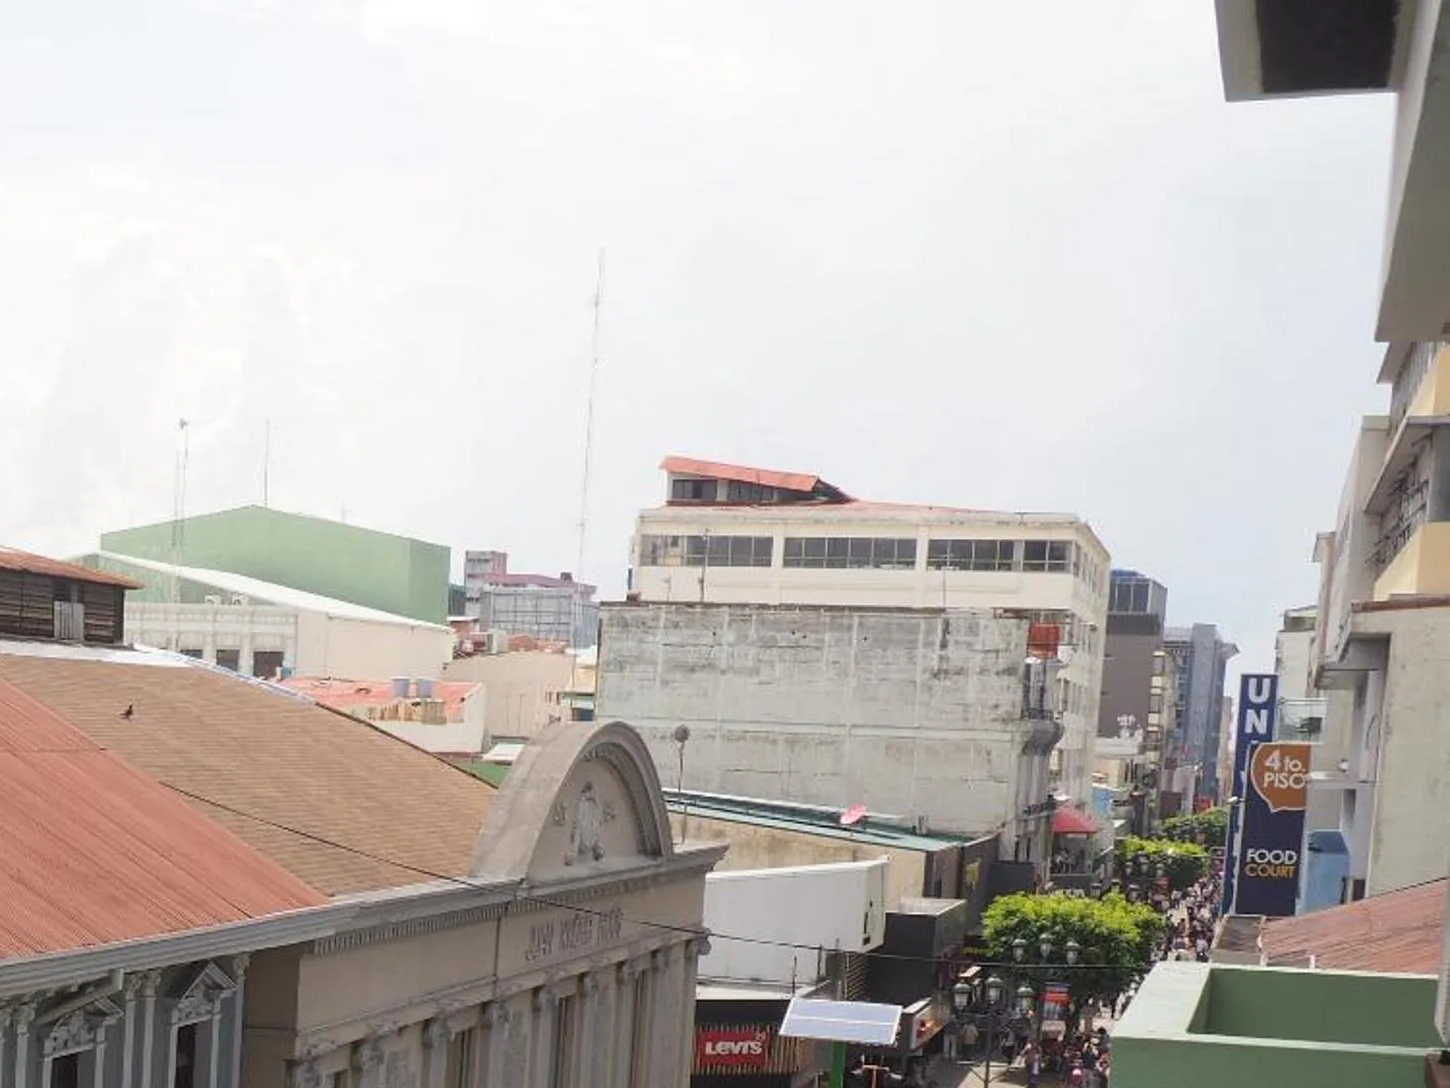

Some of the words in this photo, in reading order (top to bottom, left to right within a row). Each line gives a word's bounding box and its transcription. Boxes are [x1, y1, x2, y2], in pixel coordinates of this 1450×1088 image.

[1263, 772, 1308, 789] PISO
[1246, 848, 1297, 864] FOOD
[1244, 863, 1296, 878] COURT
